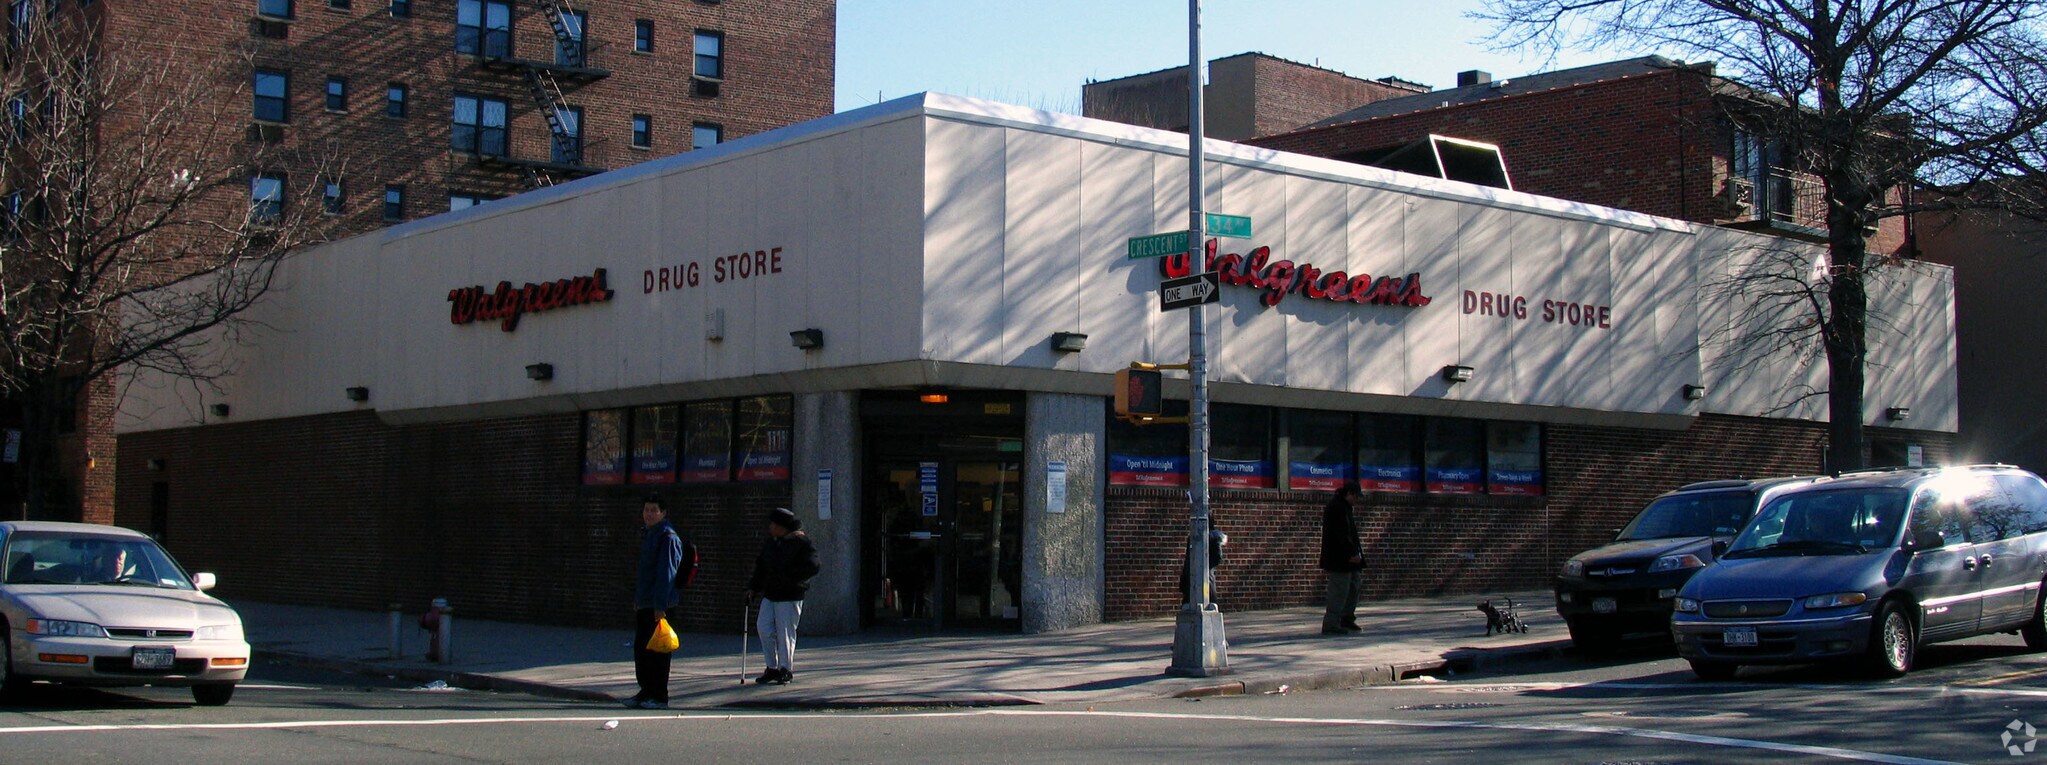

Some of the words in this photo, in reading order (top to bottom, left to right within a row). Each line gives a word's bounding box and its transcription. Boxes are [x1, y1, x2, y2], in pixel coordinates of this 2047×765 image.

[1211, 215, 1234, 234] 34
[1129, 235, 1178, 258] CRESCENT
[1180, 234, 1188, 244] ST
[643, 261, 699, 295] DRUG
[713, 246, 783, 284] STORE
[447, 267, 615, 332] Walgreens
[1165, 287, 1181, 301] ONE
[1191, 282, 1210, 297] WAY
[1462, 289, 1527, 320] DRUG
[1542, 299, 1611, 329] STORE
[1126, 459, 1140, 471] Open
[1149, 459, 1174, 472] Midnight
[1215, 461, 1226, 472] One
[1239, 462, 1254, 473] Photo
[1309, 465, 1333, 476] Cosmetics
[1377, 468, 1402, 478] Electronics
